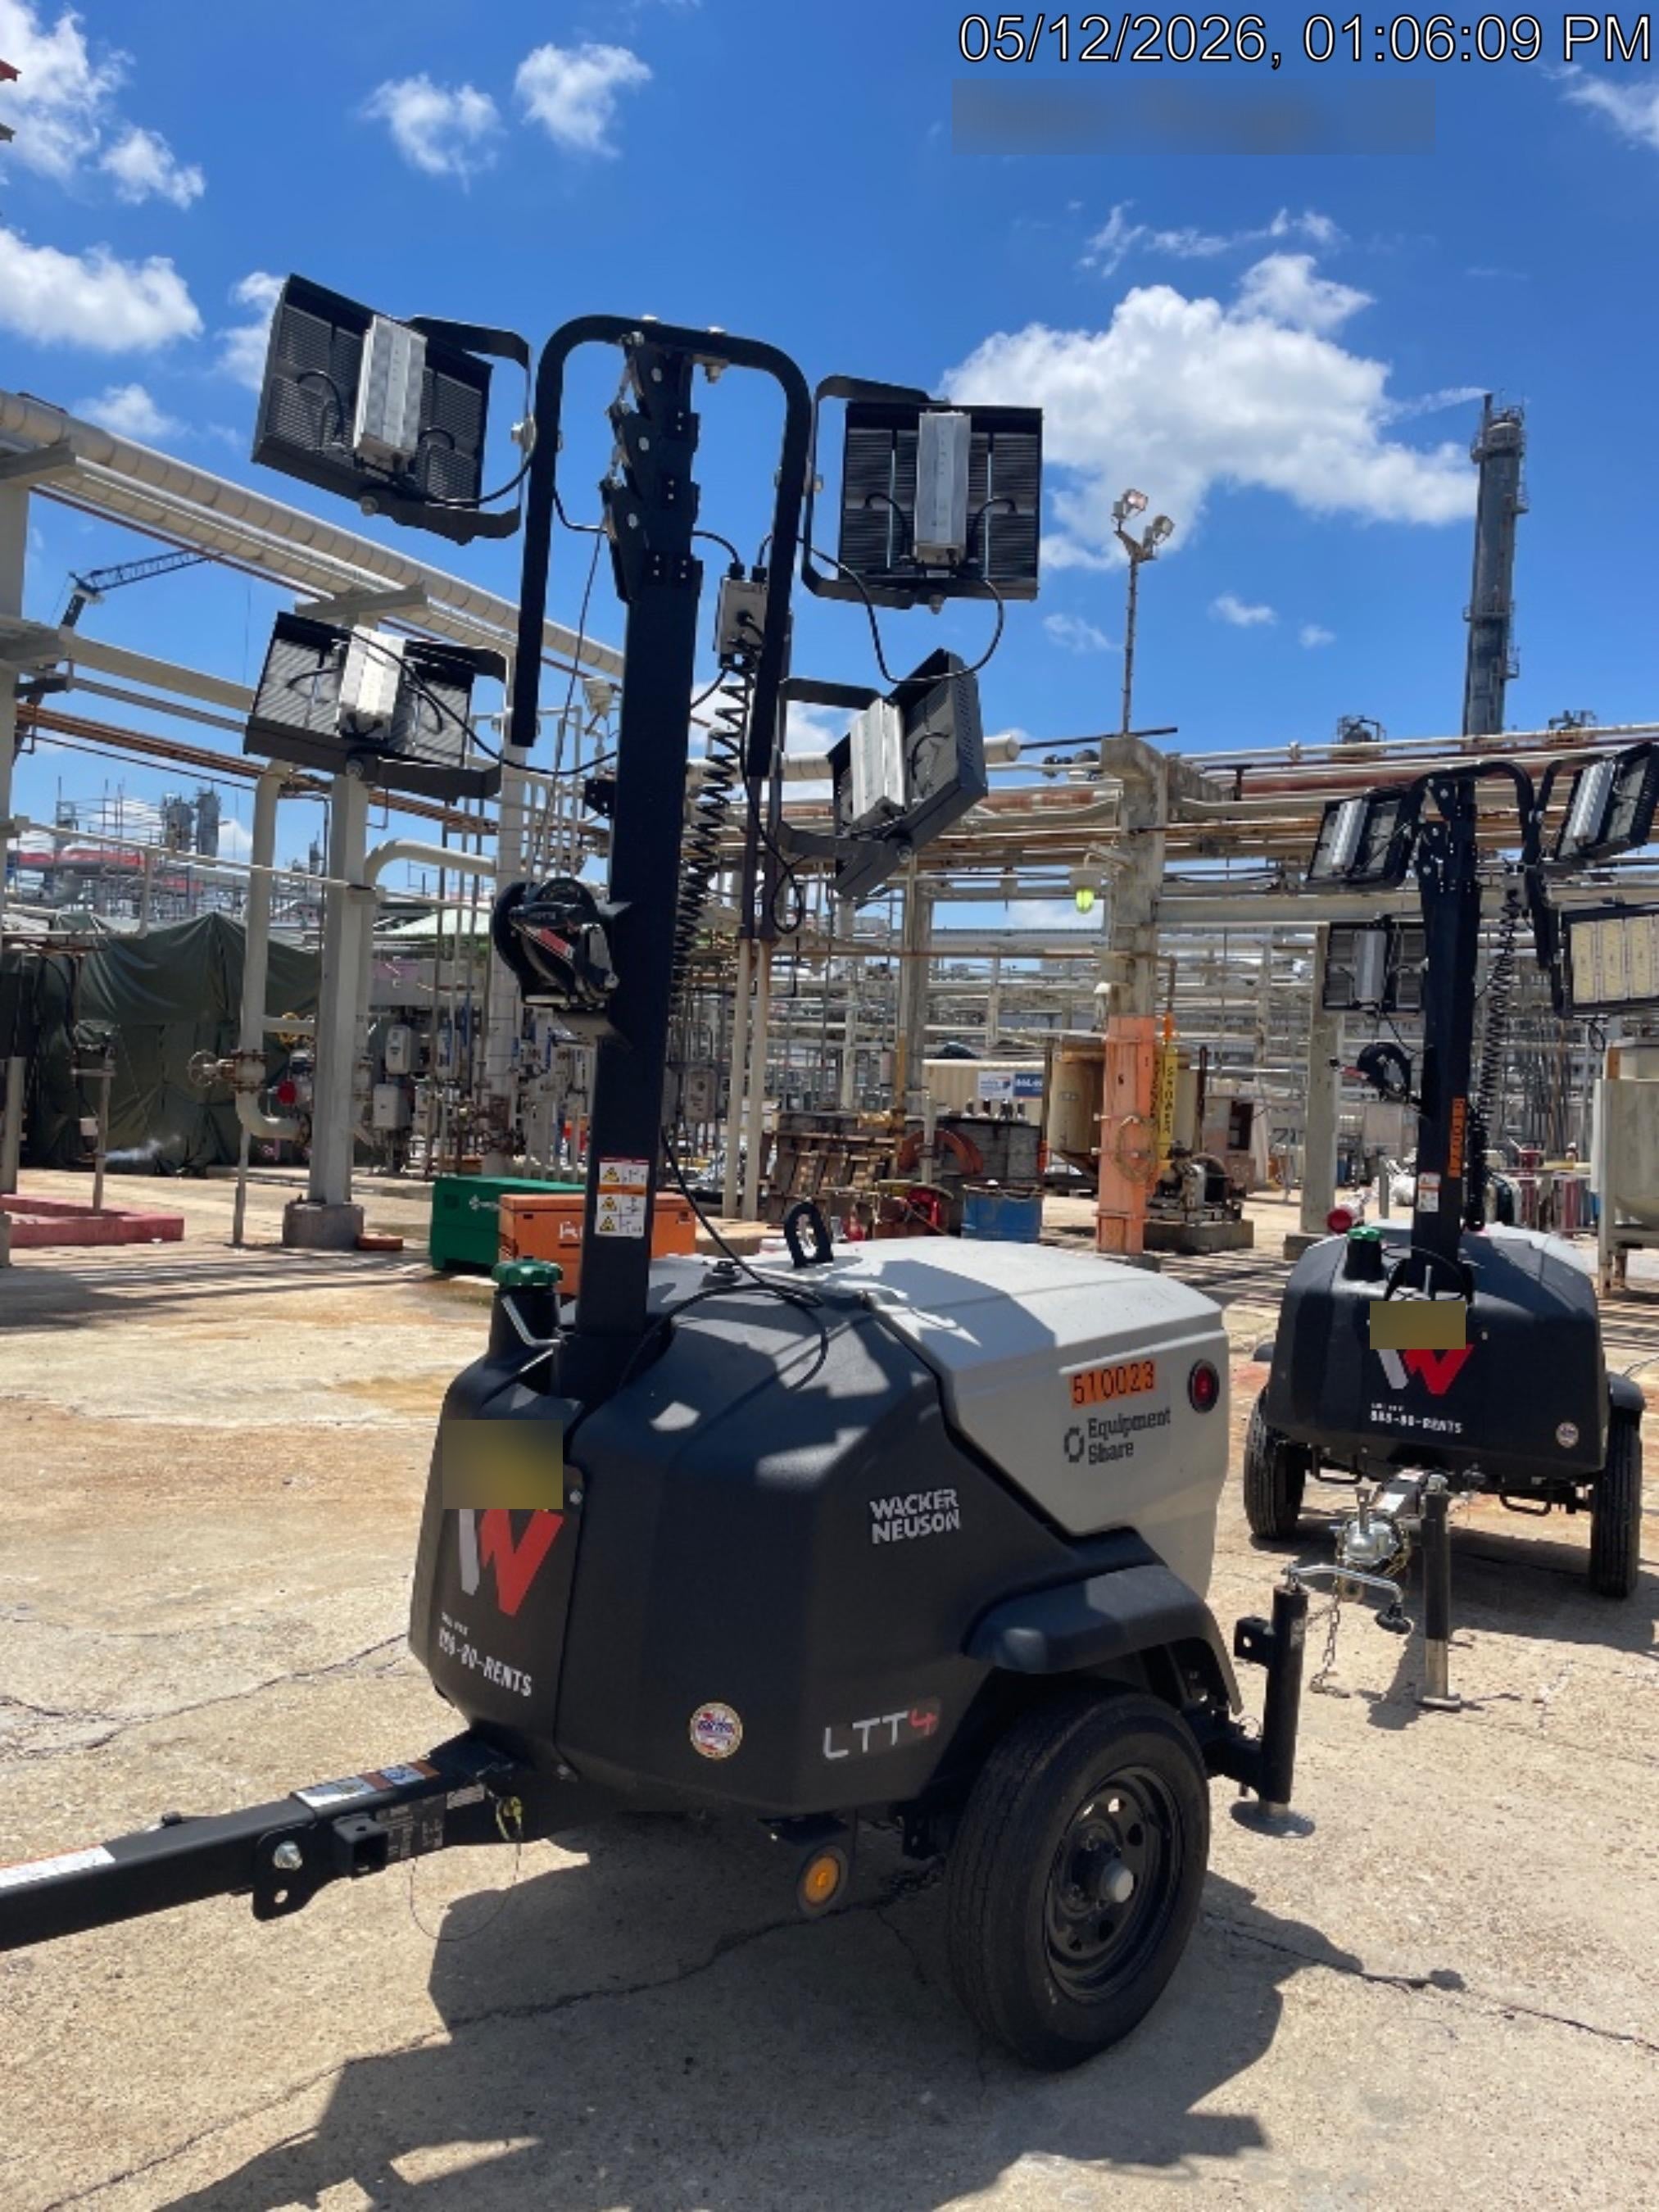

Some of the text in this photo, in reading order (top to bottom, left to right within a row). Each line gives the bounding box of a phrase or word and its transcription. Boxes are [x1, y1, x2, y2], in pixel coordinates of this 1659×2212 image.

[1073, 1361, 1154, 1404] 510023
[1088, 1407, 1171, 1441] Equipment
[1088, 1442, 1135, 1465] Share
[869, 1489, 959, 1520] WACKER
[872, 1508, 960, 1544] NEUSON
[823, 1708, 939, 1760] LTT4
